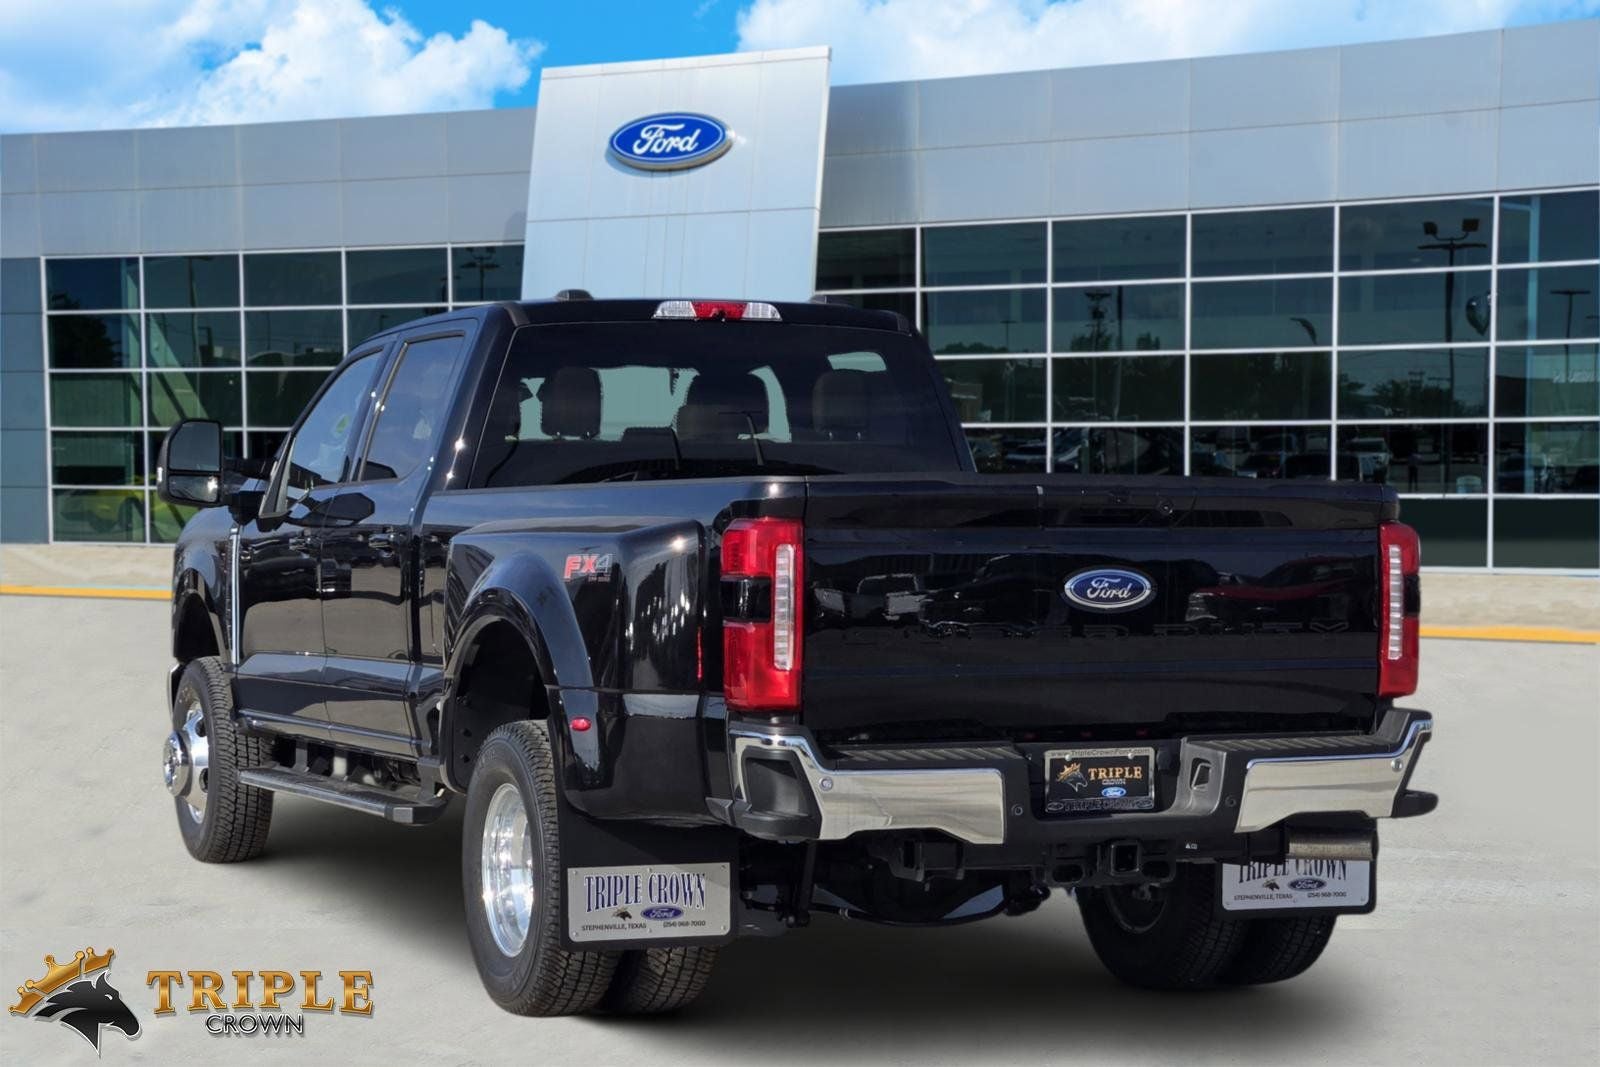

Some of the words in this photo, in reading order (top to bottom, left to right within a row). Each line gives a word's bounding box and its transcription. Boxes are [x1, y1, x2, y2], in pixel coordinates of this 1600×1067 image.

[632, 123, 702, 155] Ford
[563, 553, 615, 580] FX4
[1086, 577, 1133, 599] Ford
[1087, 766, 1144, 781] TRIPLE
[585, 873, 642, 913] TRIPLE
[648, 872, 706, 910] CROWN
[1295, 880, 1319, 890] Ford
[649, 908, 675, 919] Ford
[628, 922, 647, 930] TEXAS
